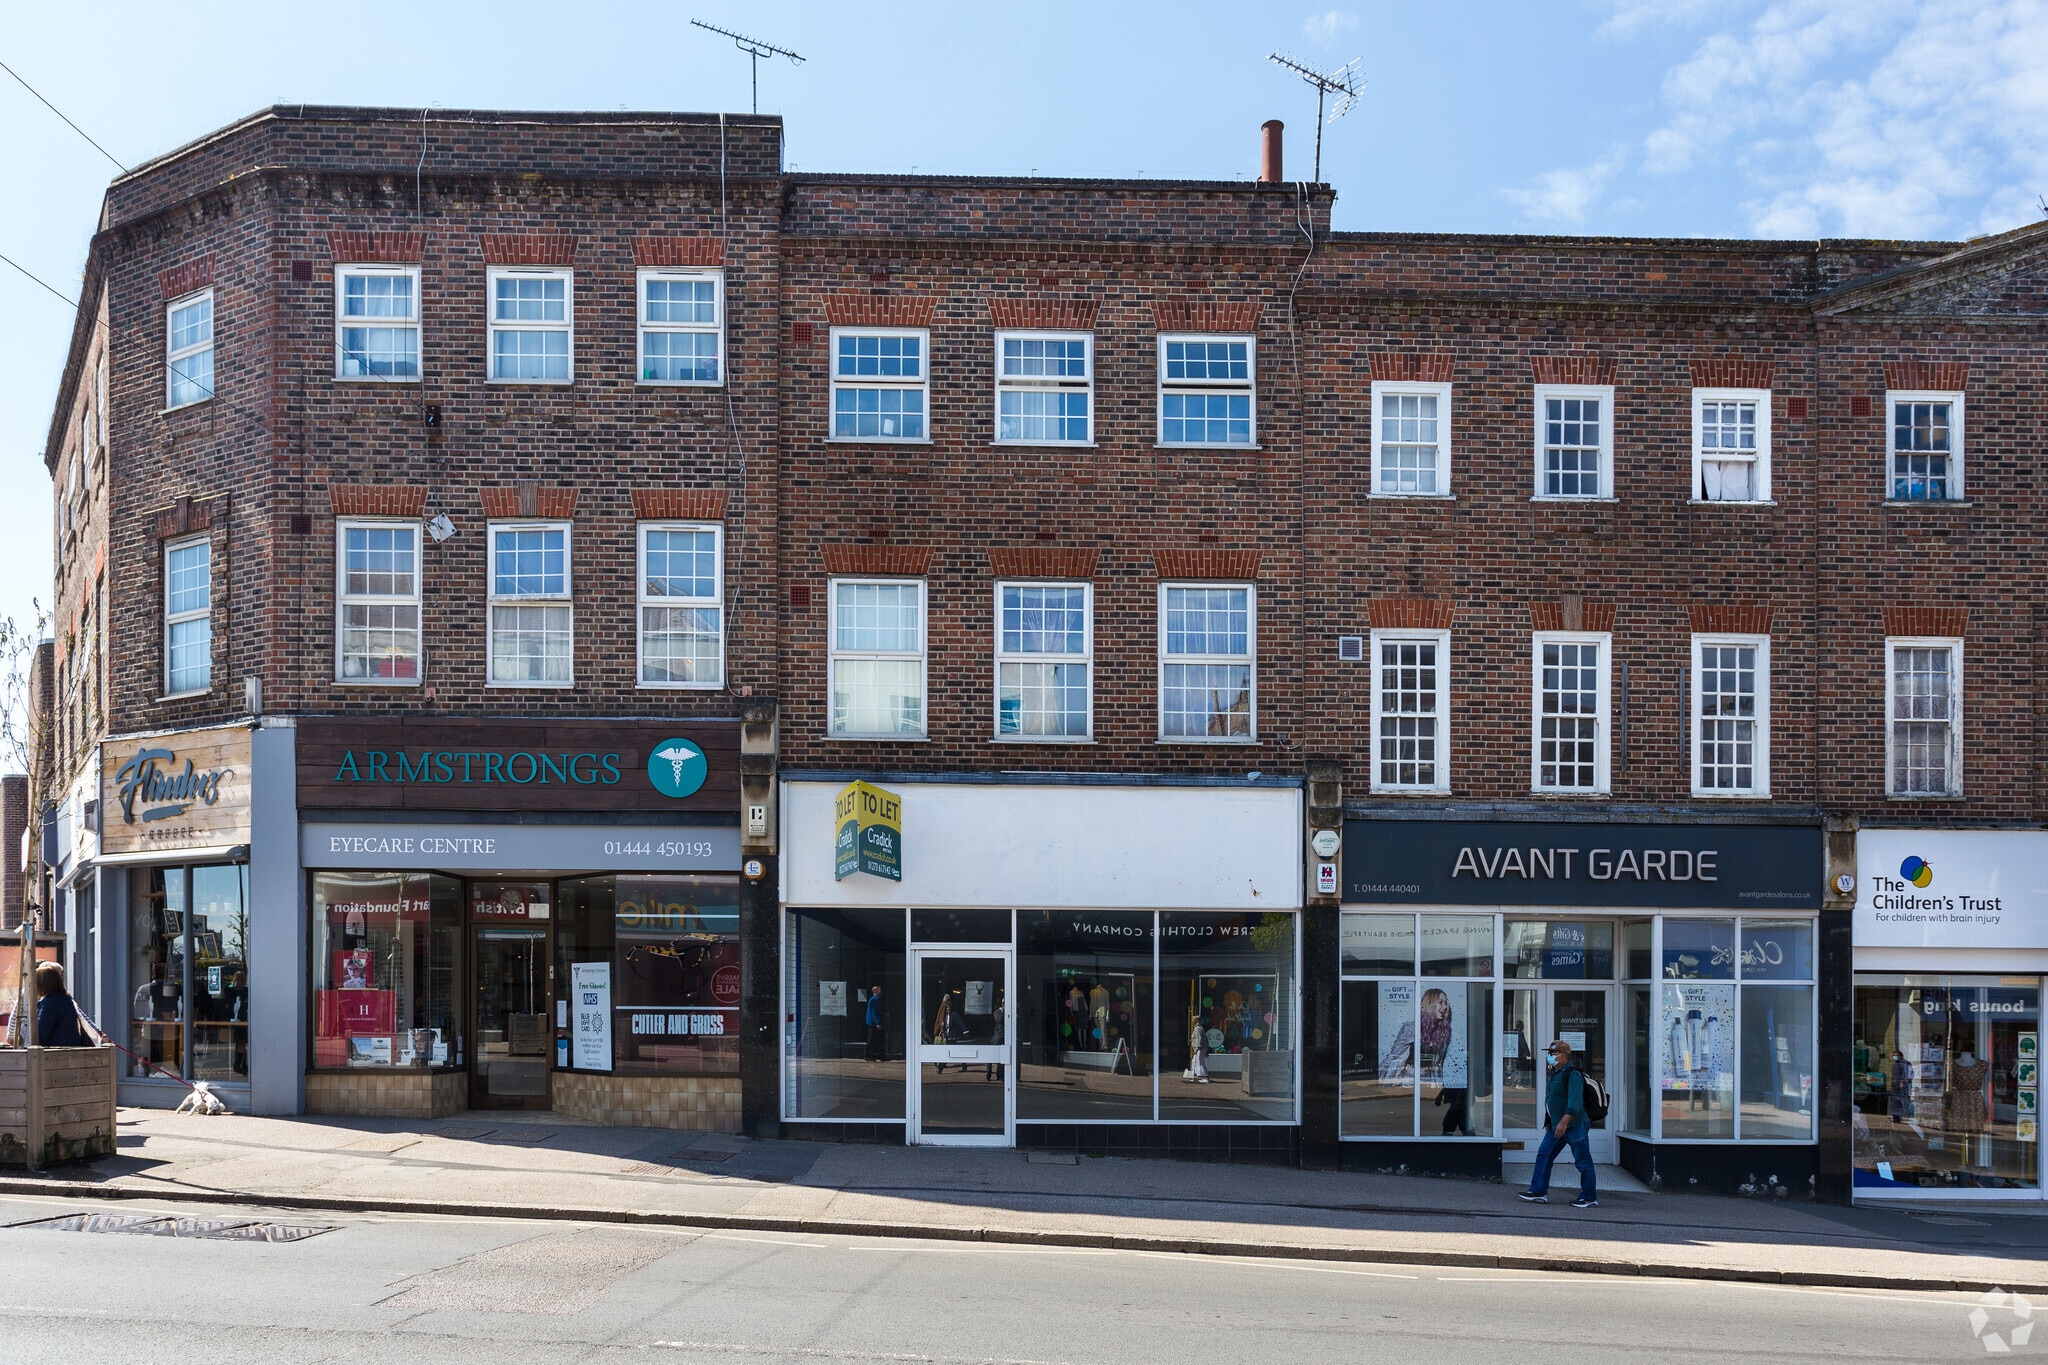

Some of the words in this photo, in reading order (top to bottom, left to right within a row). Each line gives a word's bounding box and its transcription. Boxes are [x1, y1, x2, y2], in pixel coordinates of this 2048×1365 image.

[333, 750, 622, 785] ARMSTRONGS
[844, 791, 855, 815] LET
[862, 791, 877, 814] TO
[880, 798, 898, 821] LET
[330, 836, 415, 853] EYECARE
[419, 838, 495, 854] CENTRE
[867, 827, 893, 849] Cradick
[604, 841, 651, 856] 01444
[656, 841, 712, 857] 450193
[1451, 847, 1579, 879] AVANT
[1589, 849, 1718, 881] GARDE
[1361, 884, 1387, 893] 01444
[1389, 884, 1420, 893] 440401
[1872, 877, 1904, 892] The
[1738, 891, 1811, 899] avantgardesalons.co.uk
[1873, 895, 1954, 910] Children's
[1959, 896, 2002, 911] Trust
[1875, 913, 1889, 922] For
[1891, 913, 1927, 922] children
[1928, 914, 1948, 922] with
[1950, 914, 1972, 922] brain
[1975, 914, 2000, 924] injury
[584, 993, 597, 1005] NHS
[632, 1014, 665, 1034] CUTLER
[667, 1014, 689, 1034] AND
[690, 1014, 724, 1035] GROSS
